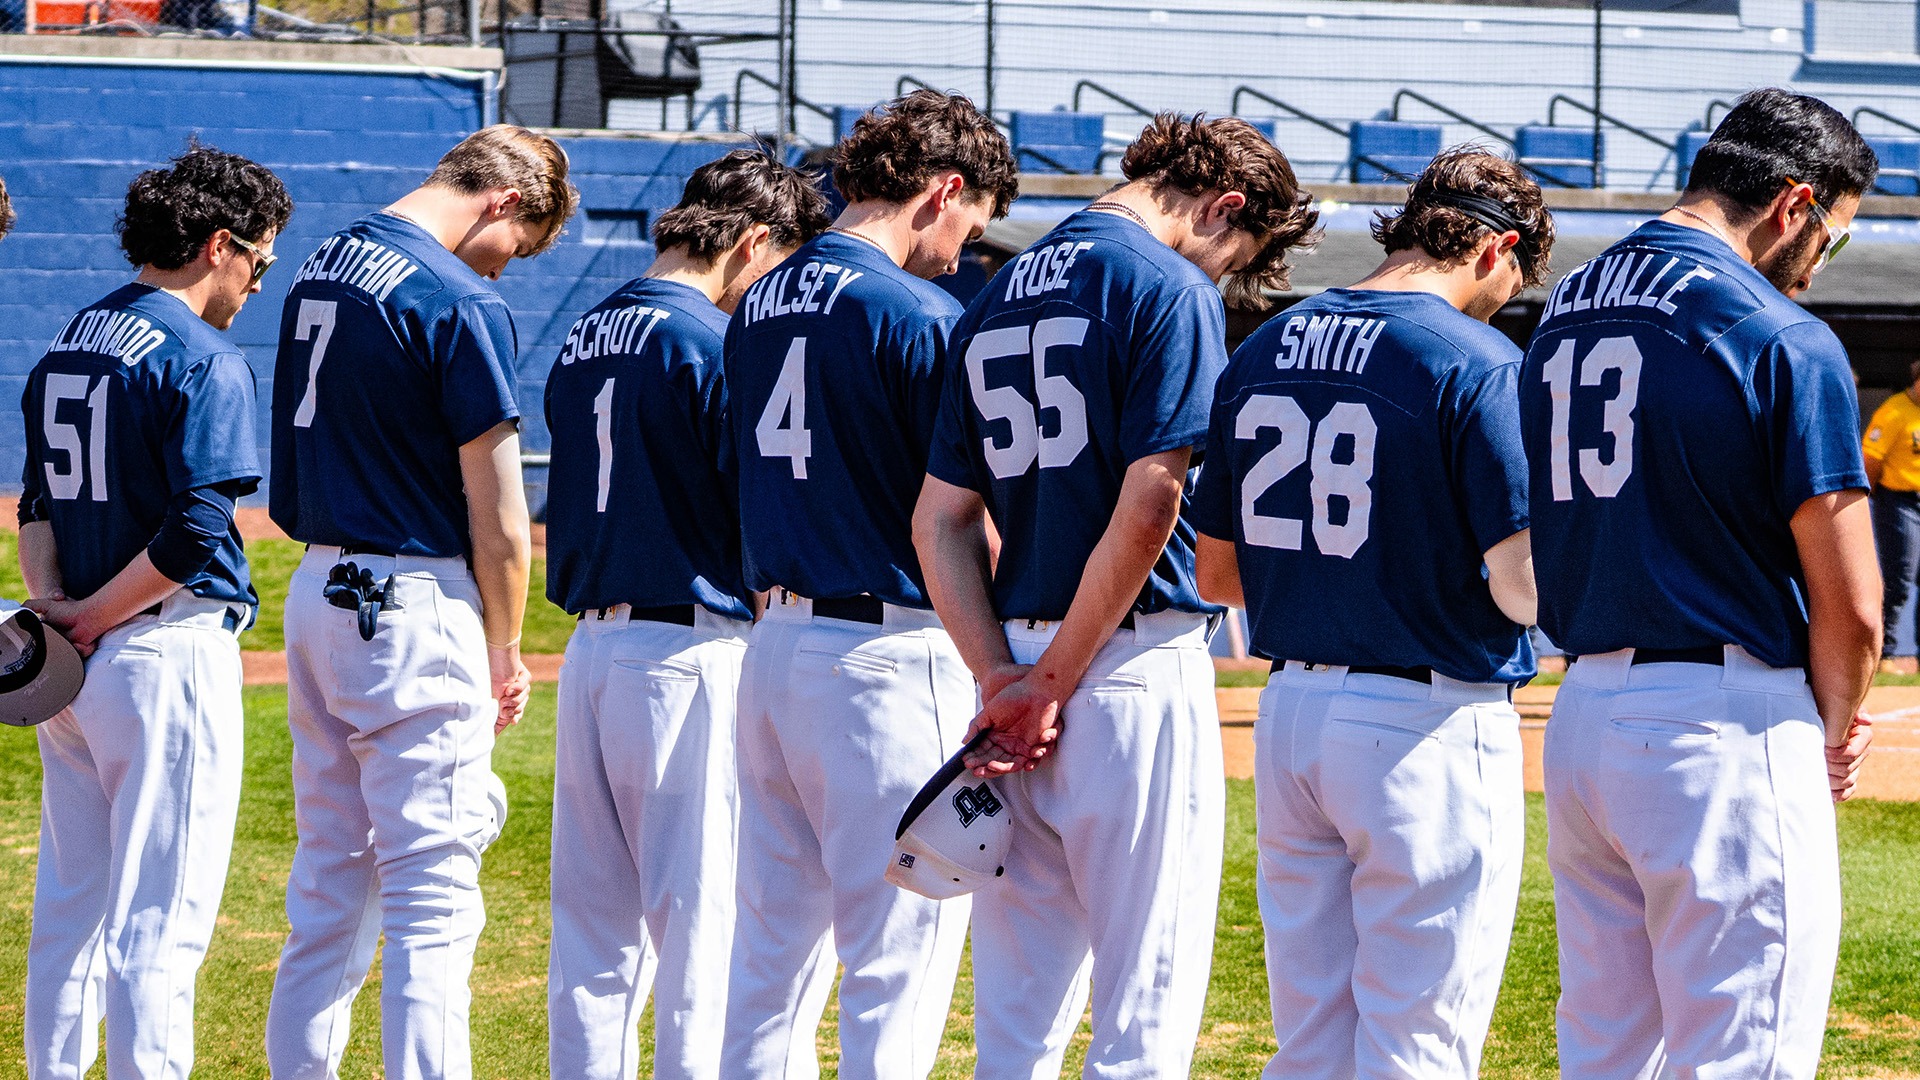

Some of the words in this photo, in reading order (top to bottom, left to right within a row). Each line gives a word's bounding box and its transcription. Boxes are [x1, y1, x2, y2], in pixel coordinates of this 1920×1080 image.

[288, 236, 418, 302] CGLOTHIN
[745, 262, 864, 327] HALSEY
[1005, 242, 1095, 302] ROSE
[1539, 252, 1716, 326] DELVALLE
[44, 309, 166, 367] ALDONADO
[294, 299, 338, 428] 7
[561, 306, 671, 365] SCHOTT
[1275, 316, 1386, 374] SMITH
[44, 373, 109, 502] 51
[593, 378, 616, 512] 1
[755, 337, 812, 479] 4
[965, 317, 1091, 479] 55
[1542, 336, 1643, 501] 13
[1234, 394, 1378, 559] 28
